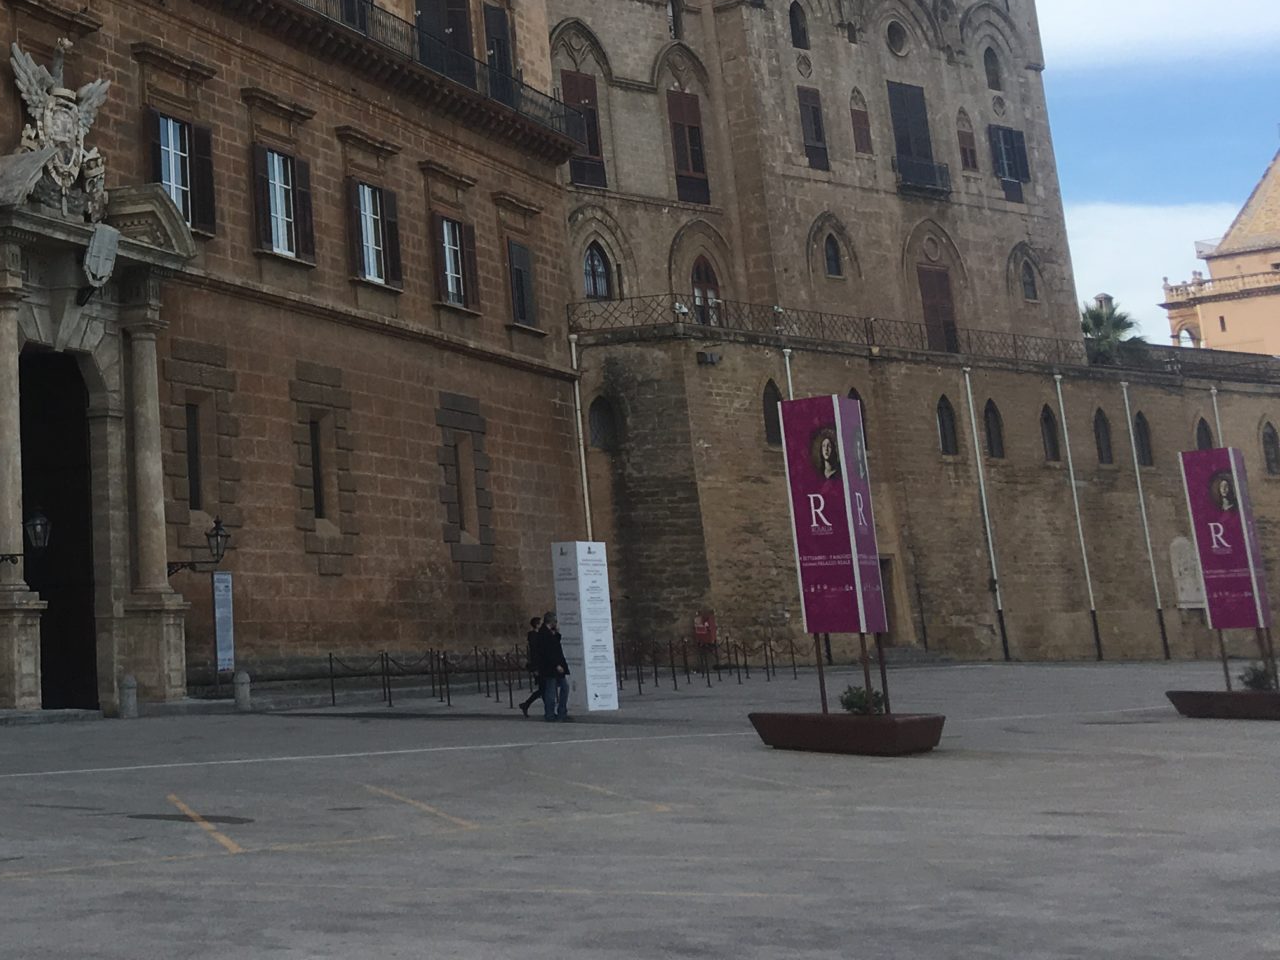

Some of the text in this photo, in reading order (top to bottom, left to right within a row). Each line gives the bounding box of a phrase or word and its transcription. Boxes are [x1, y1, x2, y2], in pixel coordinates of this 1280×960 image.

[807, 494, 832, 527] R
[855, 492, 867, 526] R
[1208, 522, 1232, 549] R
